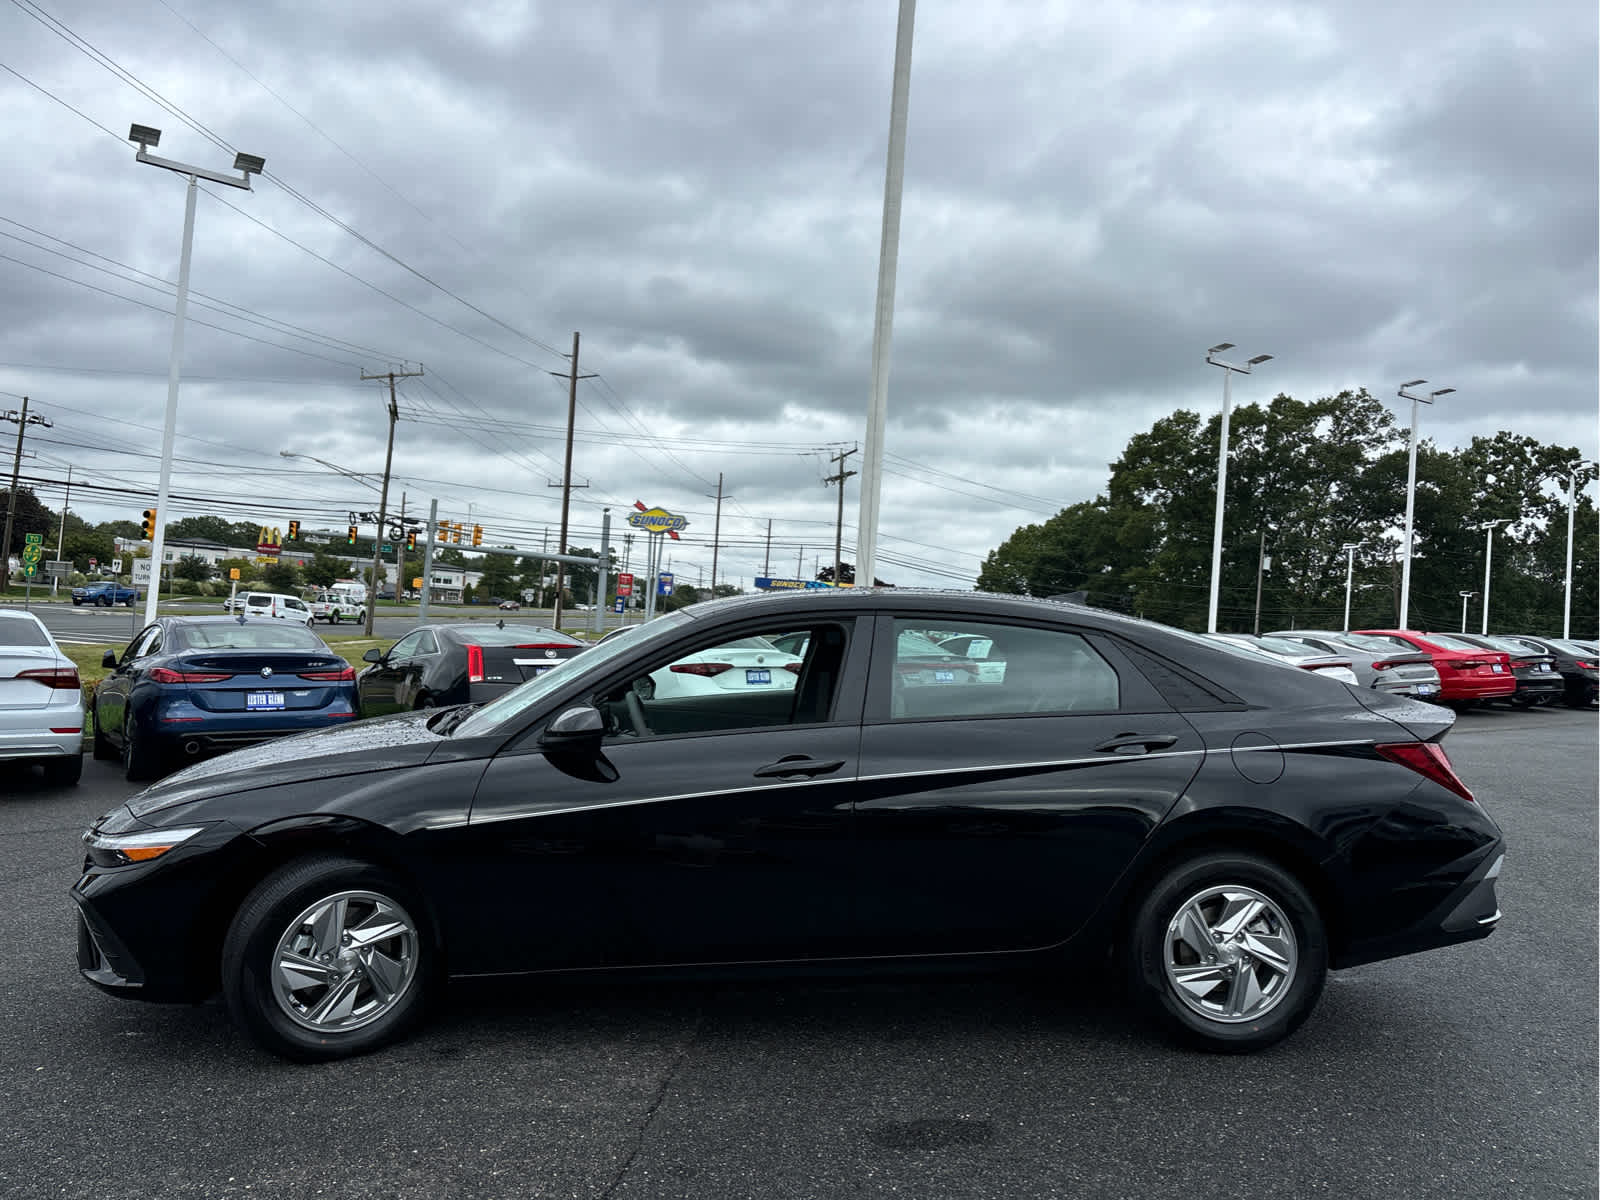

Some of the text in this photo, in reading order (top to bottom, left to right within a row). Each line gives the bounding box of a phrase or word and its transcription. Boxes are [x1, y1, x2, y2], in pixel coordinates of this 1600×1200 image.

[632, 515, 682, 527] SUNOCO
[140, 563, 151, 571] NO
[770, 580, 806, 589] SUNOCO
